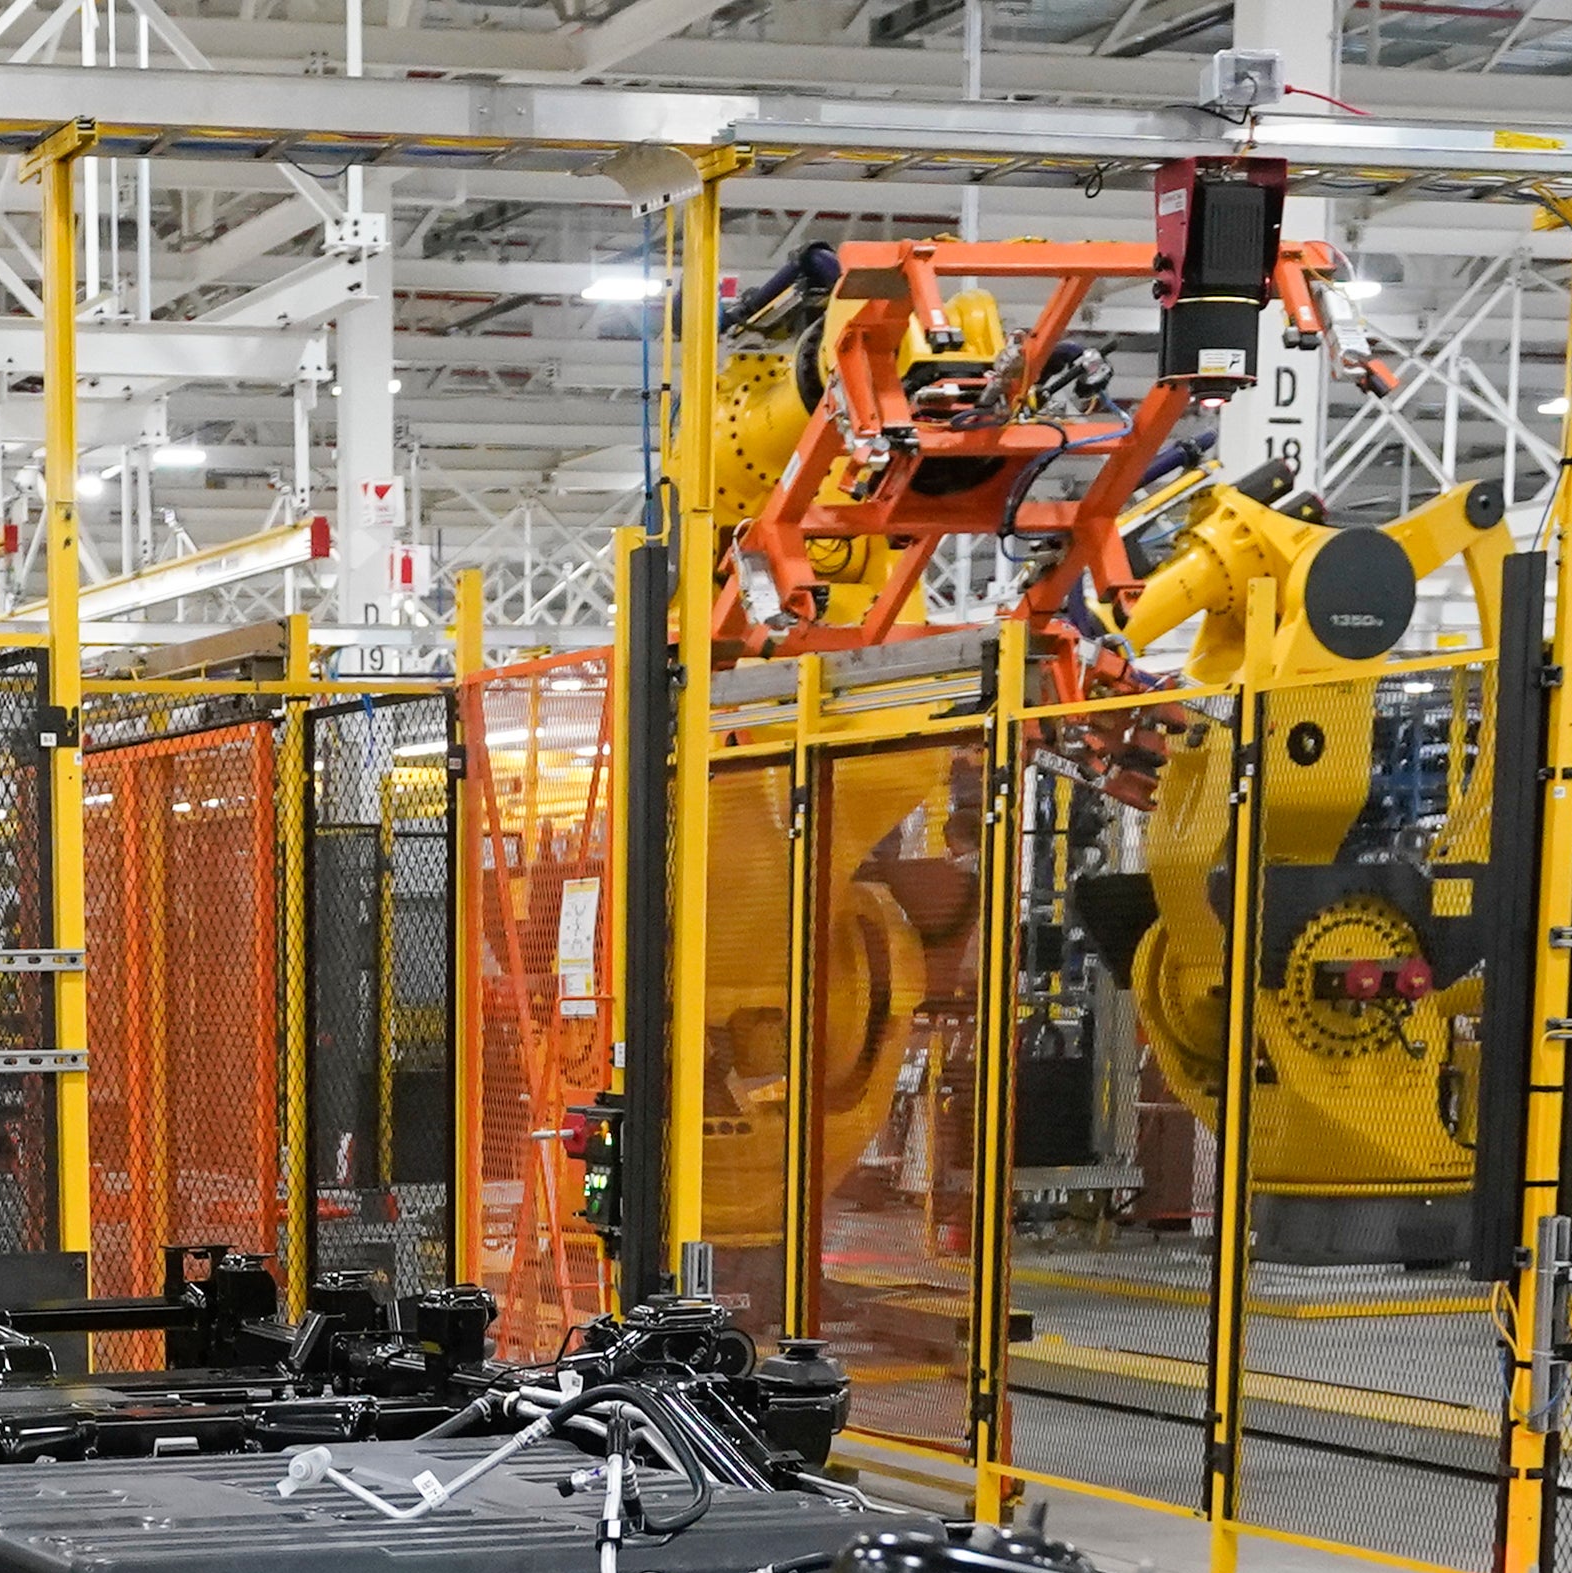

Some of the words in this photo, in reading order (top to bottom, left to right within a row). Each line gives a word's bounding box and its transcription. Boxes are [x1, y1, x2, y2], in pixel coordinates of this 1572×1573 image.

[1274, 366, 1296, 407] D
[1266, 436, 1301, 476] 18
[359, 646, 384, 672] 19
